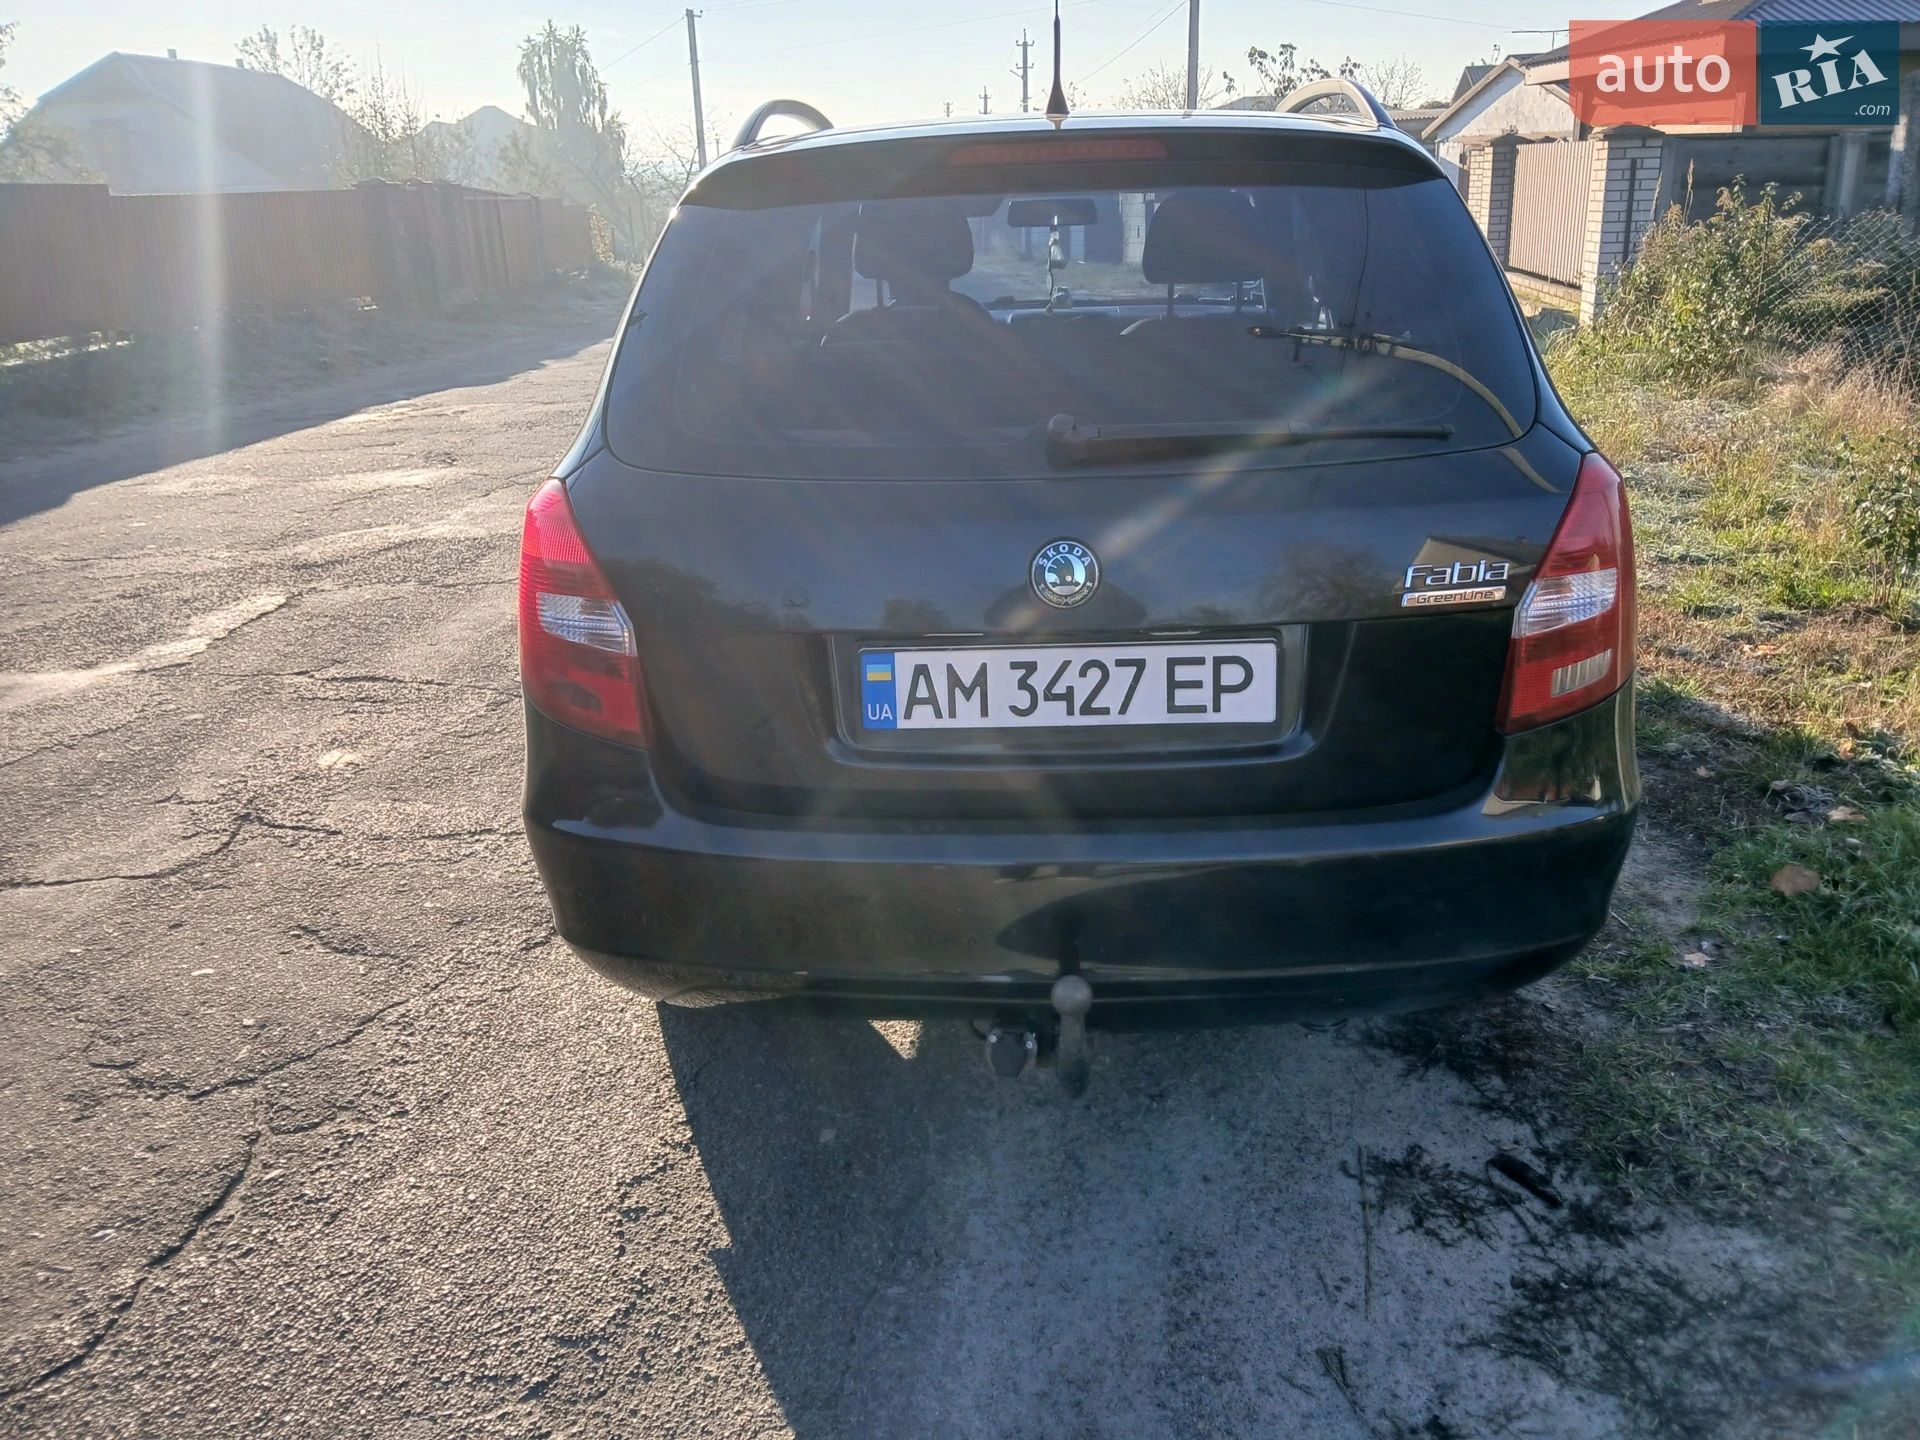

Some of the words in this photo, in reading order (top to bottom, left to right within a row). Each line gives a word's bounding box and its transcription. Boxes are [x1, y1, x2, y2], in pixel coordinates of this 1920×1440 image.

[1404, 559, 1510, 589] Fabia
[903, 661, 989, 720] AM
[1008, 657, 1147, 718] 3427
[1166, 655, 1254, 715] EP
[867, 703, 894, 721] UA
